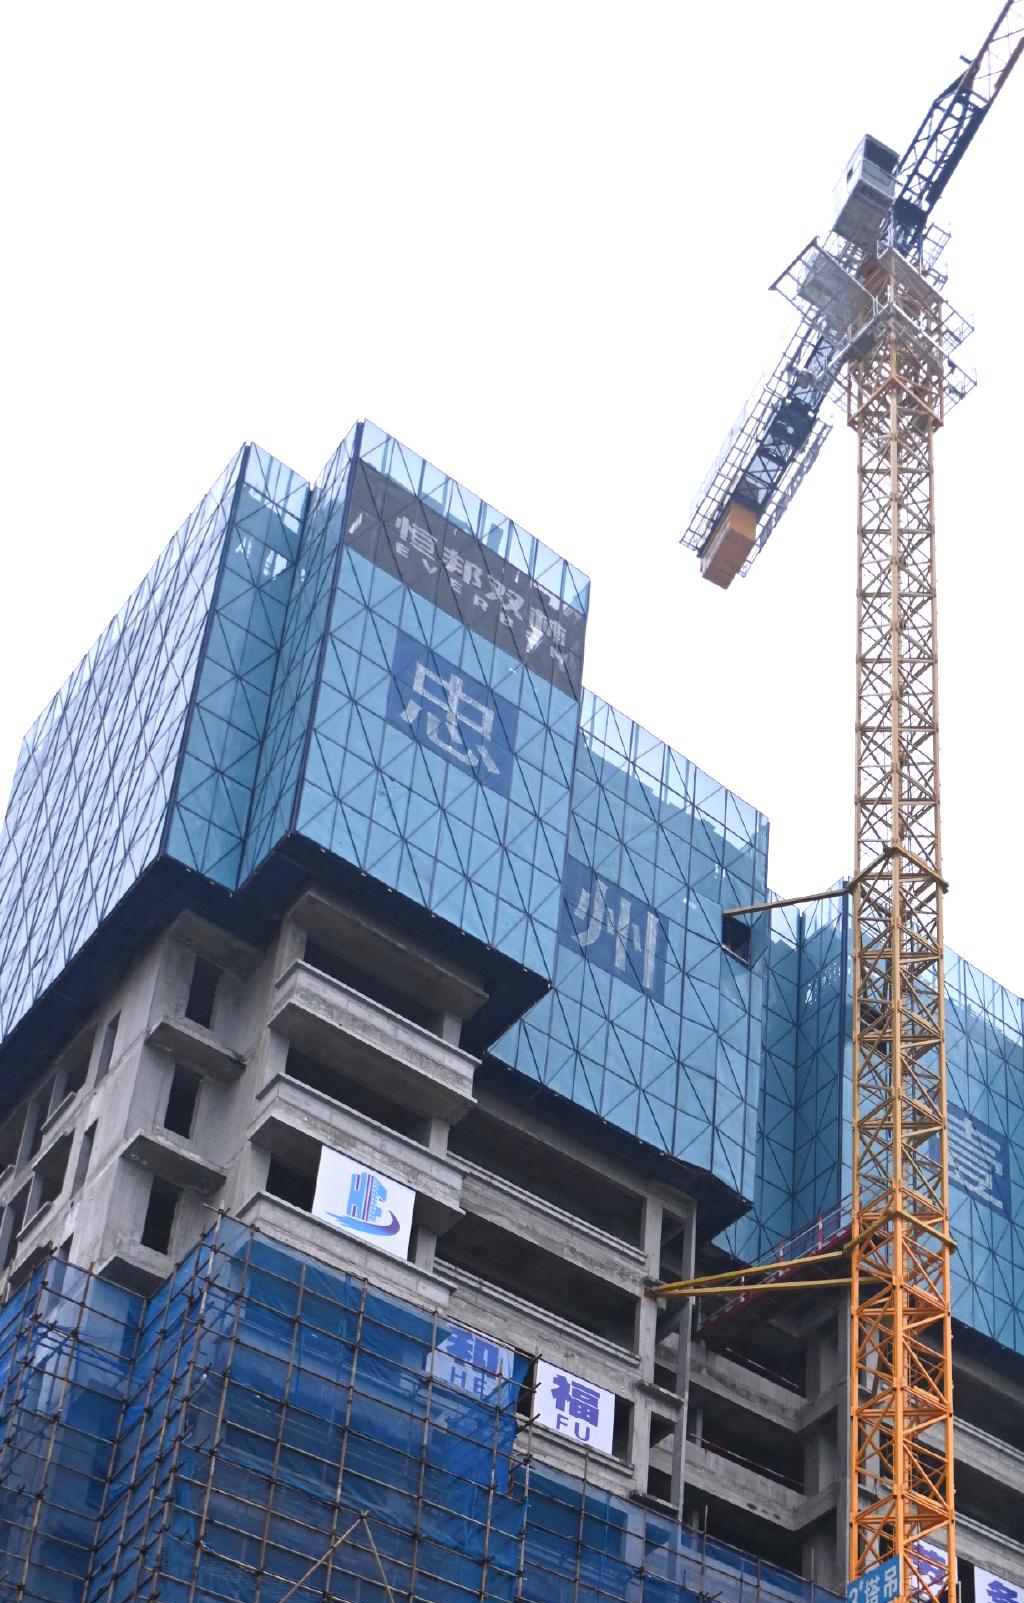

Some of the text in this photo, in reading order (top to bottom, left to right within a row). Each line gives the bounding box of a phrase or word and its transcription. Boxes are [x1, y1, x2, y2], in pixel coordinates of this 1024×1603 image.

[400, 660, 502, 776] 忠
[571, 880, 659, 989] 州
[551, 1374, 601, 1427] 福
[556, 1412, 591, 1442] FU
